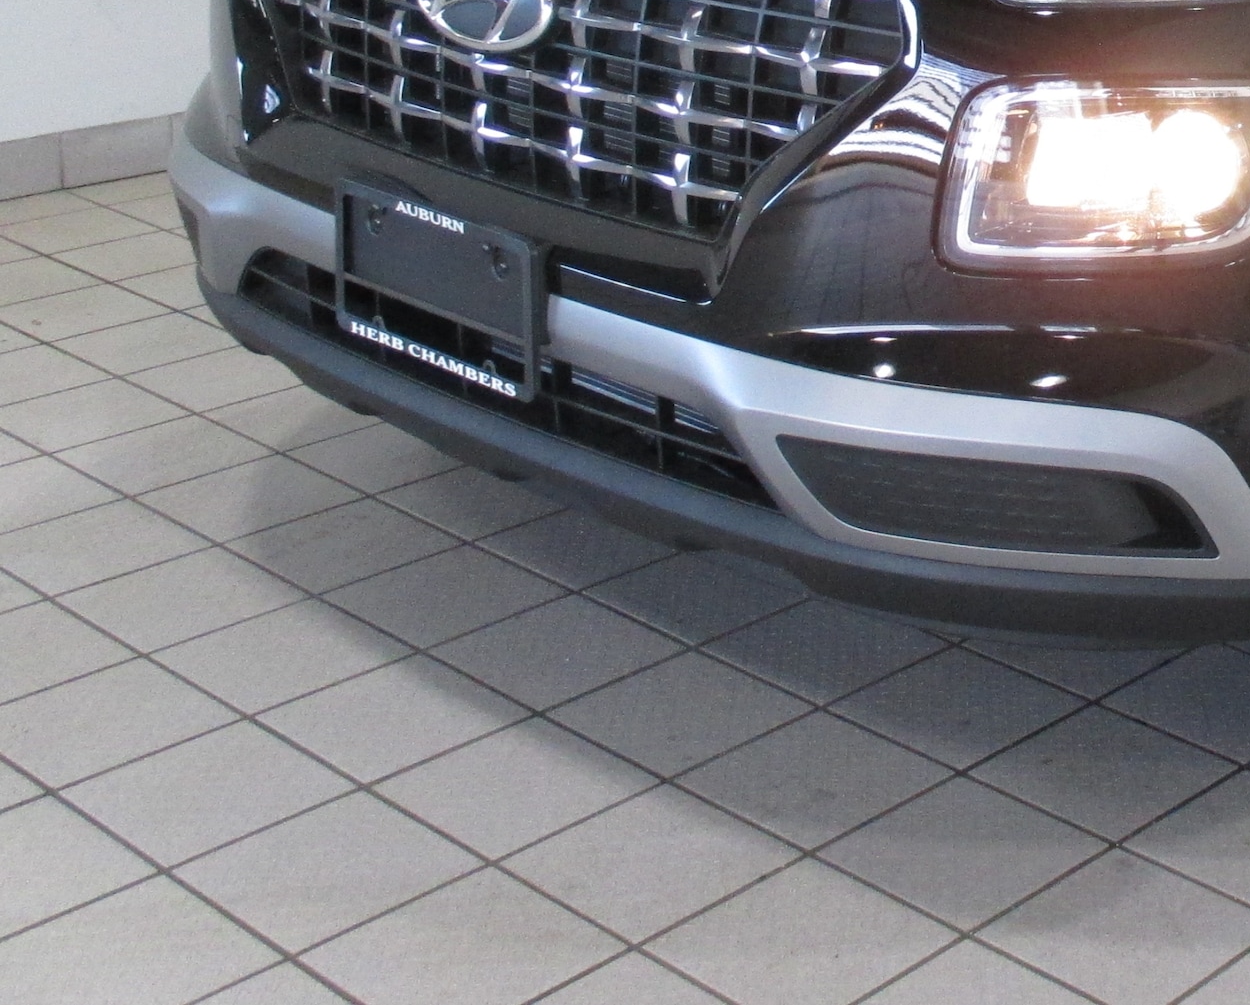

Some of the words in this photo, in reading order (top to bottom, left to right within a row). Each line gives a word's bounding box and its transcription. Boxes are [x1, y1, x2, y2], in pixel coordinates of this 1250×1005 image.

[395, 200, 465, 234] AUBURN
[351, 321, 404, 351] HERB
[407, 343, 517, 397] CHAMBERS
